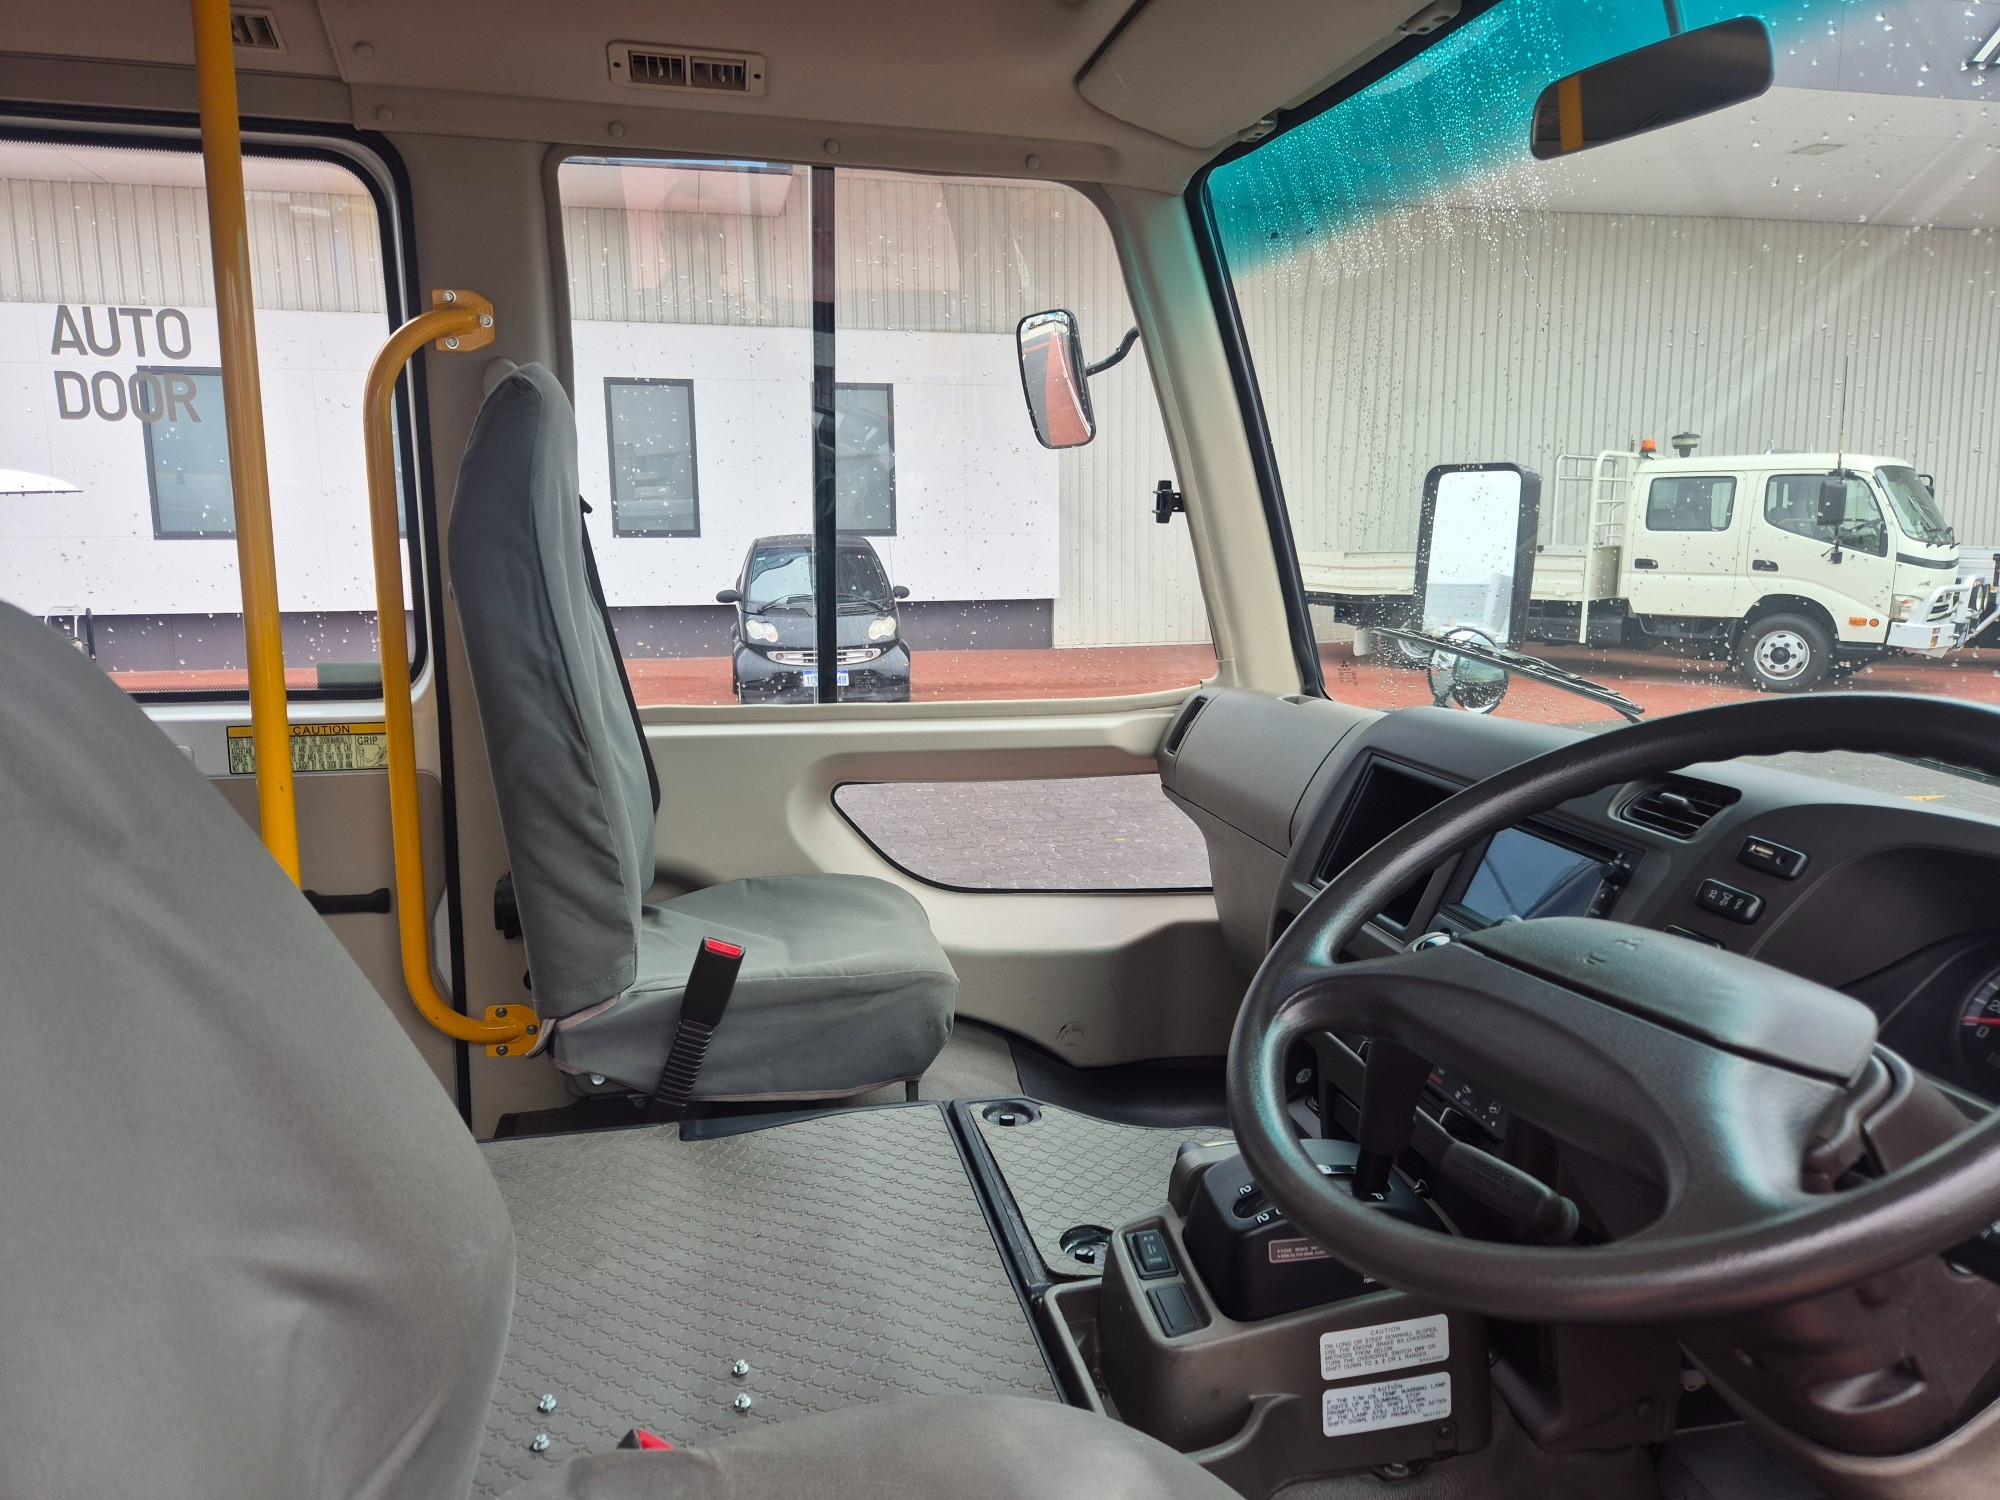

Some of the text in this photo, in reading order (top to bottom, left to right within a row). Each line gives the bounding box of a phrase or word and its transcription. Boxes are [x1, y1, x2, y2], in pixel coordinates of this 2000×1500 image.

[51, 304, 191, 359] AUTO
[54, 370, 201, 423] DOOR
[293, 725, 350, 735] CAUTION
[357, 736, 378, 745] GRIP
[1976, 1026, 1989, 1038] 0
[1239, 1184, 1252, 1196] 2
[1371, 1192, 1384, 1201] P
[1256, 1212, 1270, 1224] 2
[1370, 1326, 1400, 1336] CAUTION
[1385, 1331, 1413, 1340] DOWNHILL
[1353, 1343, 1373, 1351] ENGINE
[1376, 1340, 1393, 1348] BRAKE
[1407, 1333, 1435, 1342] CHOOSING
[1325, 1352, 1352, 1360] METHODS
[1357, 1353, 1388, 1362] OVERDRIVE
[1391, 1348, 1412, 1356] SWITCH
[1372, 1383, 1402, 1393] CAUTION
[1401, 1385, 1427, 1394] WARNING
